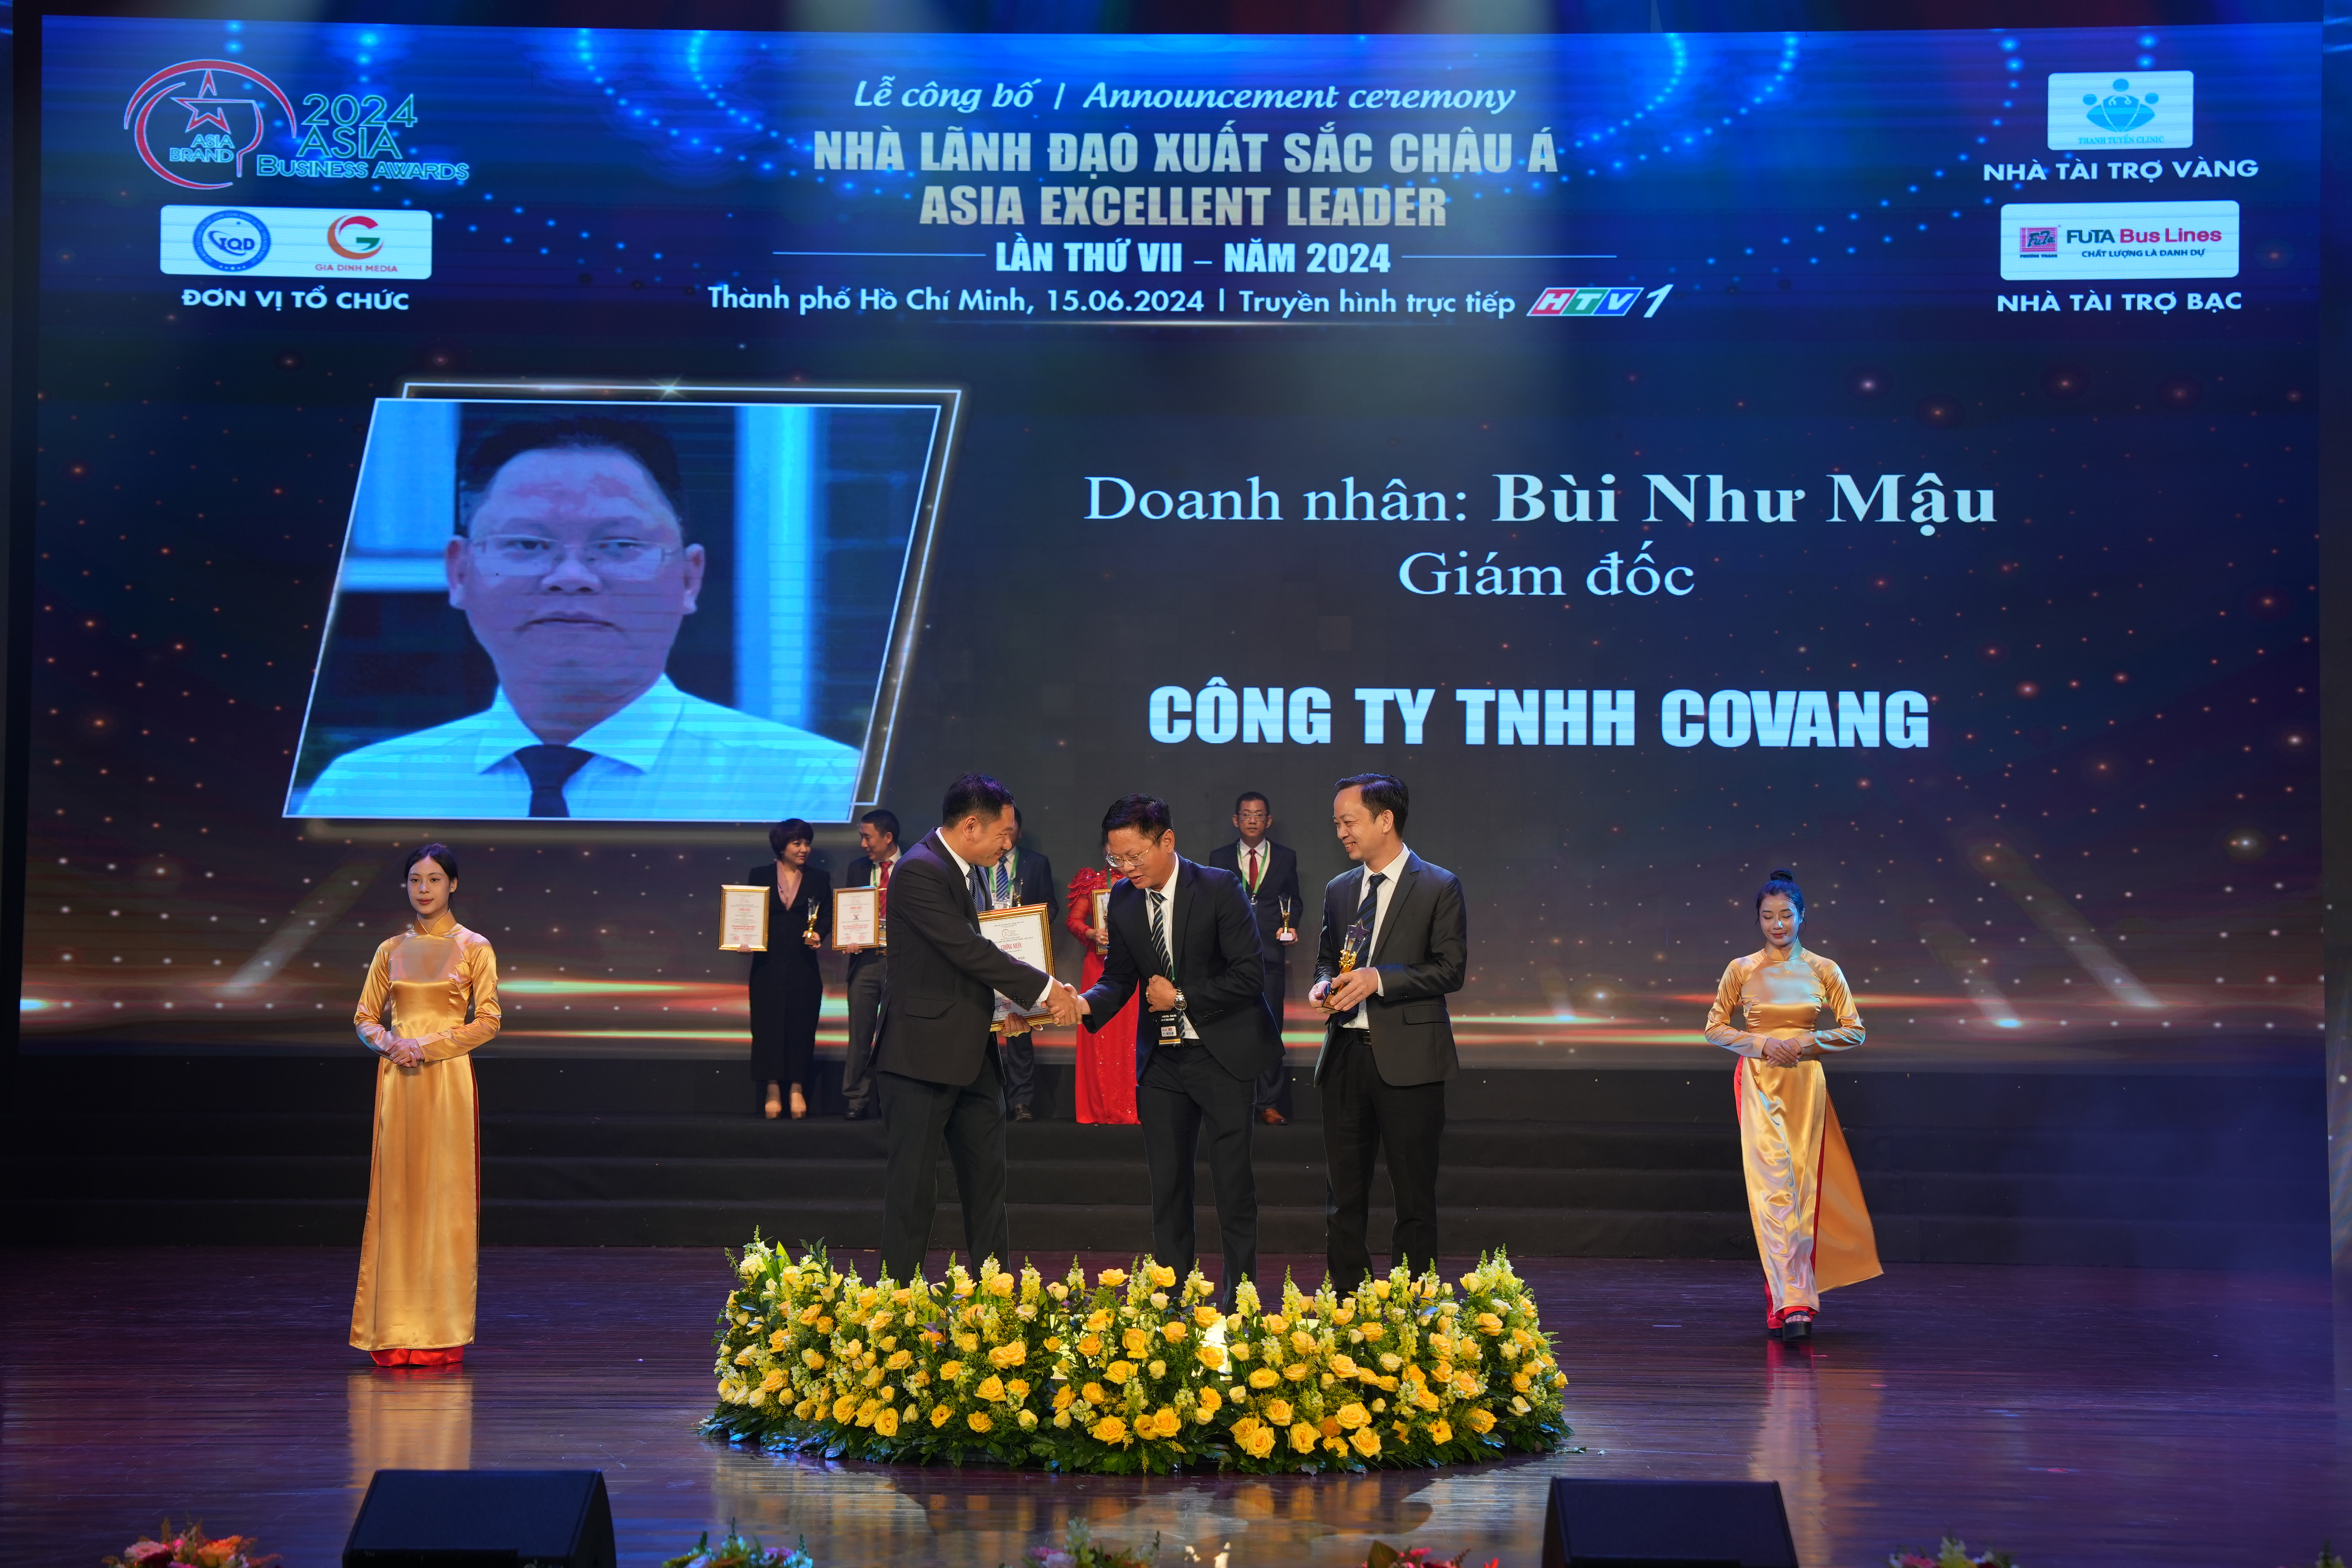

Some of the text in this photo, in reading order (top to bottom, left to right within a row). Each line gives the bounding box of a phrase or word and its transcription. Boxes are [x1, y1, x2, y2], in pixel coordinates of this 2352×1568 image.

[301, 93, 418, 127] 2024
[854, 75, 895, 106] Lễ
[901, 82, 982, 113] công
[992, 78, 1042, 107] bố
[1083, 82, 1339, 108] Announcement
[1349, 86, 1516, 114] ceremony
[169, 148, 234, 163] BRAND
[190, 134, 235, 149] ASIA
[296, 127, 403, 159] ASIA
[814, 120, 1558, 179] NHÀ LÃNH ĐẠO XUẤT SẮC CHÂU Á
[1984, 157, 2258, 183] NHÀ TÀI TRỢ VÀNG
[920, 185, 1446, 226] ASIA EXCELLENT LEADER
[219, 238, 255, 250] IQD
[2067, 228, 2222, 243] FUTA Bus Lines
[996, 233, 1052, 271] LẦN
[1064, 238, 1131, 272] THỨ
[1138, 243, 1182, 272] VII
[1225, 238, 1295, 272] NĂM
[1307, 243, 1390, 273] 2024
[2081, 249, 2107, 258] CHẤT
[2109, 250, 2143, 258] LƯỢNG
[2190, 248, 2206, 258] DỰ
[182, 285, 408, 311] ĐƠN VỊ TỔ CHỨC
[708, 284, 789, 308] Thành
[800, 285, 850, 315] phố
[861, 288, 897, 309] Hồ
[906, 287, 950, 310] Chí
[959, 287, 1034, 314] Minh,
[1048, 290, 1204, 311] 15.06.2024
[1239, 290, 1329, 318] Truyền
[1340, 288, 1396, 312] hình
[1407, 294, 1456, 317] trực
[1466, 291, 1515, 319] tiếp
[1998, 290, 2241, 314] NHÀ TÀI TRỢ BẠC
[1084, 473, 1997, 536] Doanh nhân: Bùi Như Mậu
[1400, 541, 1694, 595] Giám đốc
[1149, 677, 1928, 748] CÔNG TY TNHH COVANG
